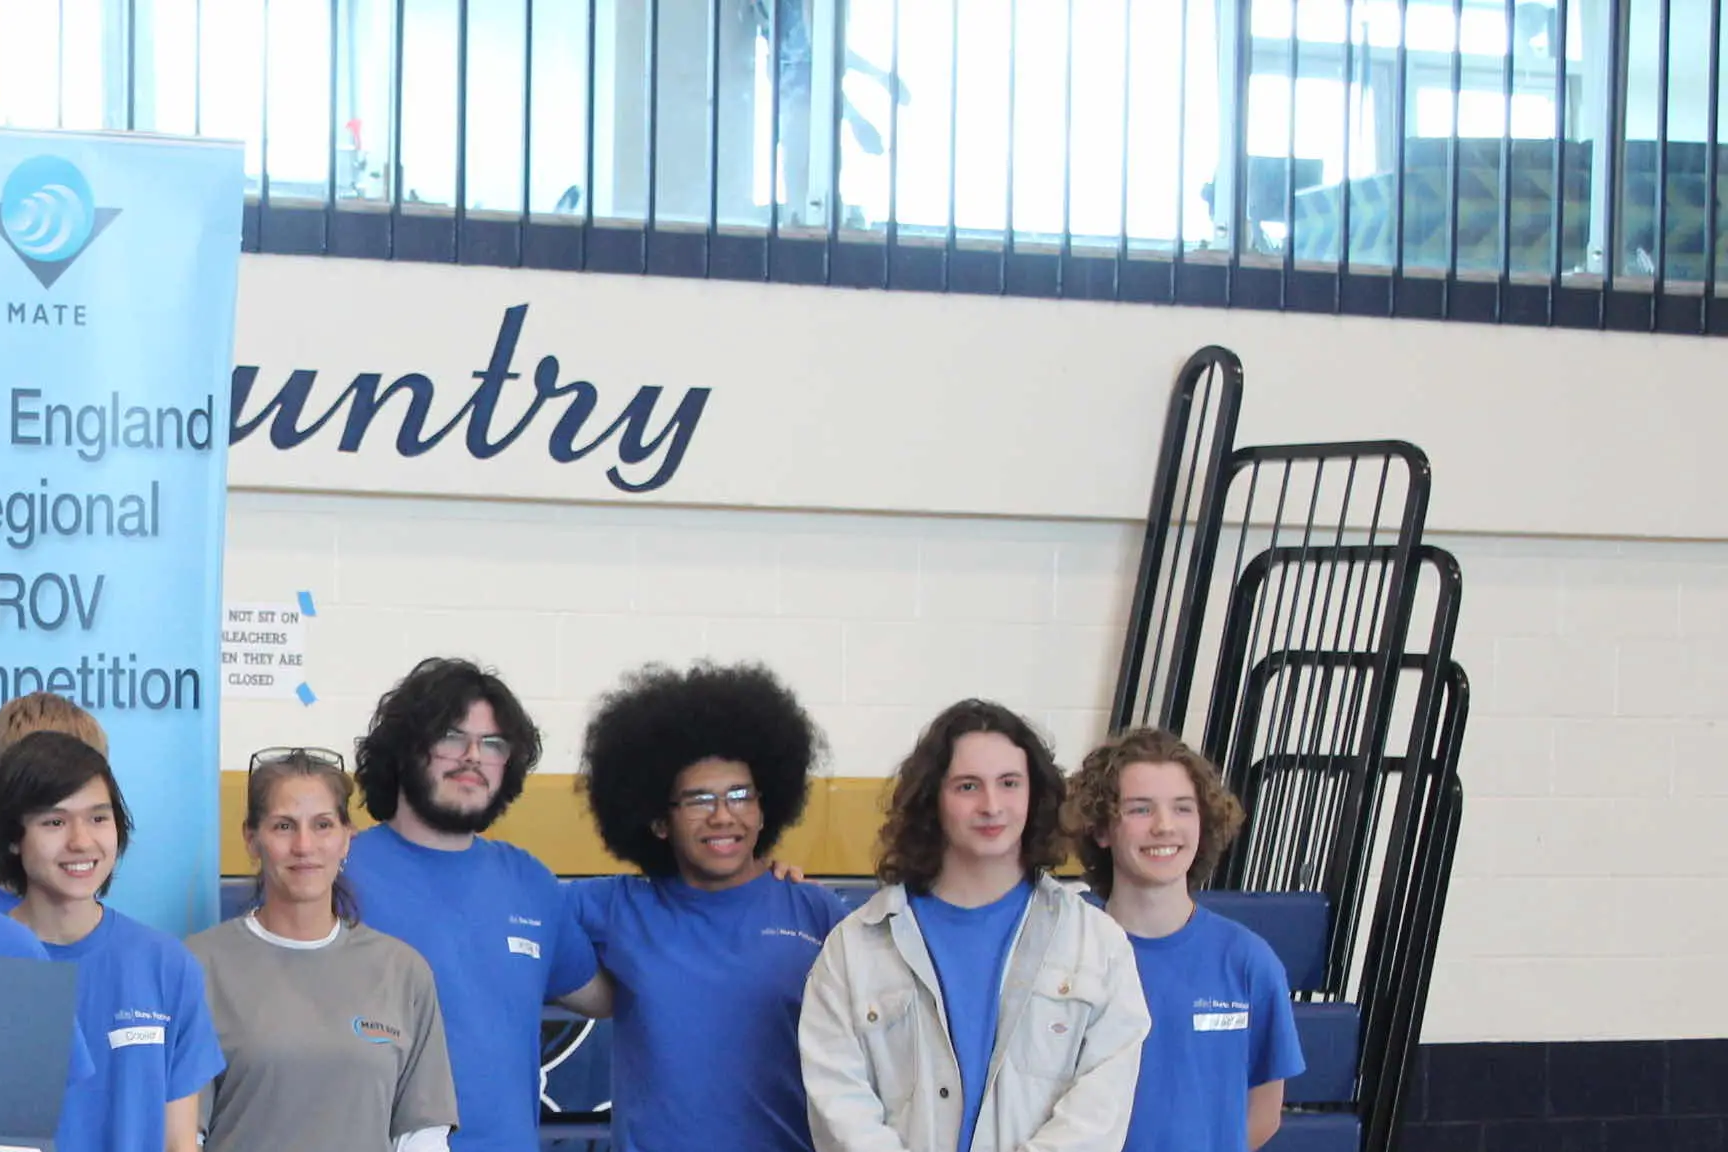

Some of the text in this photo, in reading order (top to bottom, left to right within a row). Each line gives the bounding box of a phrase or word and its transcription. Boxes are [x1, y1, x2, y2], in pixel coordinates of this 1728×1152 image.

[8, 302, 87, 326] MATE
[11, 388, 214, 462] England
[229, 610, 299, 624] NOT SIT ON
[243, 652, 273, 665] THEY
[279, 654, 303, 666] ARE
[228, 673, 274, 686] CLOSED
